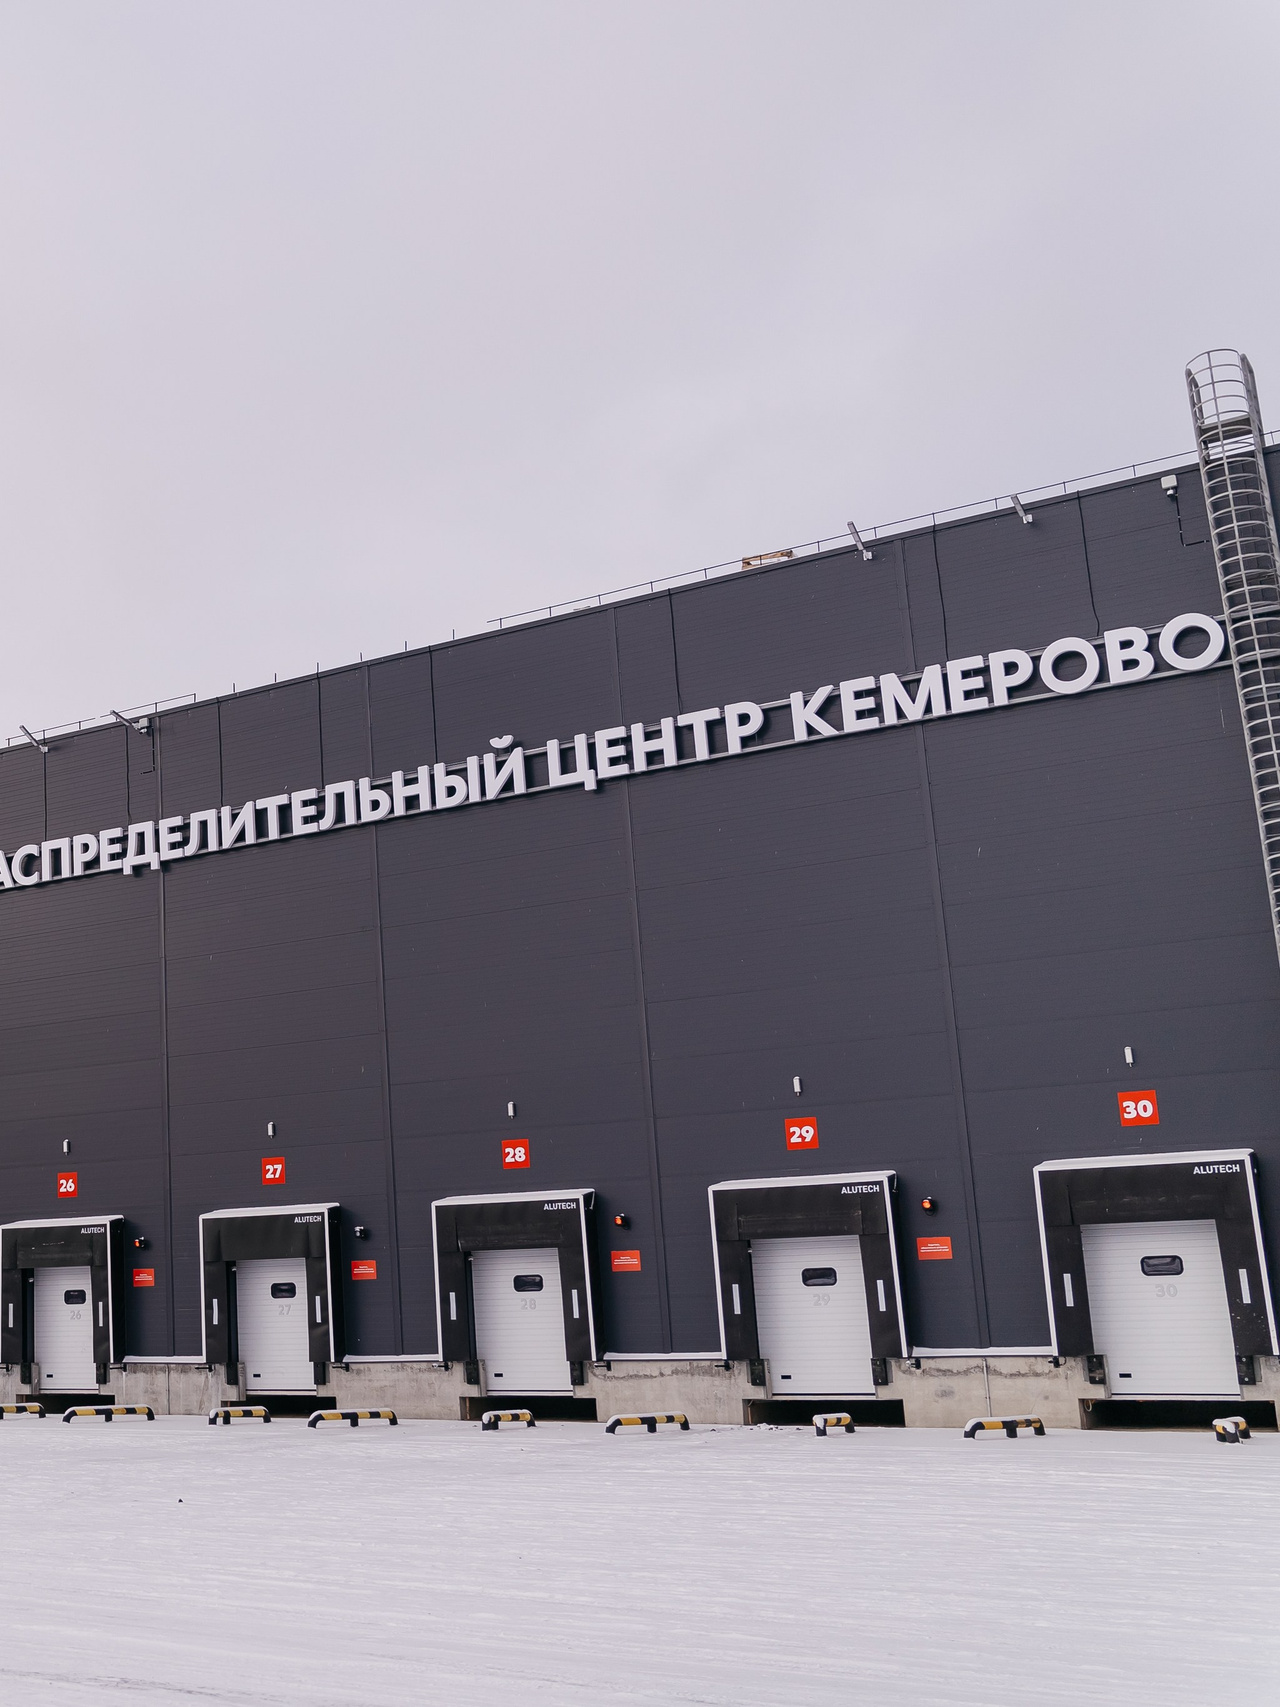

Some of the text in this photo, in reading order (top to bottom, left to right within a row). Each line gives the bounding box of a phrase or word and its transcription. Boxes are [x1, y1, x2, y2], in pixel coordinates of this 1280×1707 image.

[546, 701, 765, 790] ЦЕНТР
[790, 612, 1226, 742] КЕМЕРОВО
[1122, 1099, 1154, 1119] 30
[789, 1125, 815, 1143] 29
[504, 1147, 526, 1163] 28
[265, 1164, 282, 1179] 27
[1193, 1163, 1241, 1175] ALUTECH
[59, 1179, 75, 1193] 26
[840, 1184, 880, 1195] ALUTECH
[543, 1201, 577, 1211] ALUTECH
[294, 1215, 322, 1224] ALUTECH
[80, 1226, 105, 1235] ALUTECH
[1155, 1284, 1178, 1298] 30
[521, 1298, 537, 1310] 28
[813, 1294, 830, 1307] 29
[70, 1310, 82, 1320] 26
[278, 1304, 291, 1316] 27
